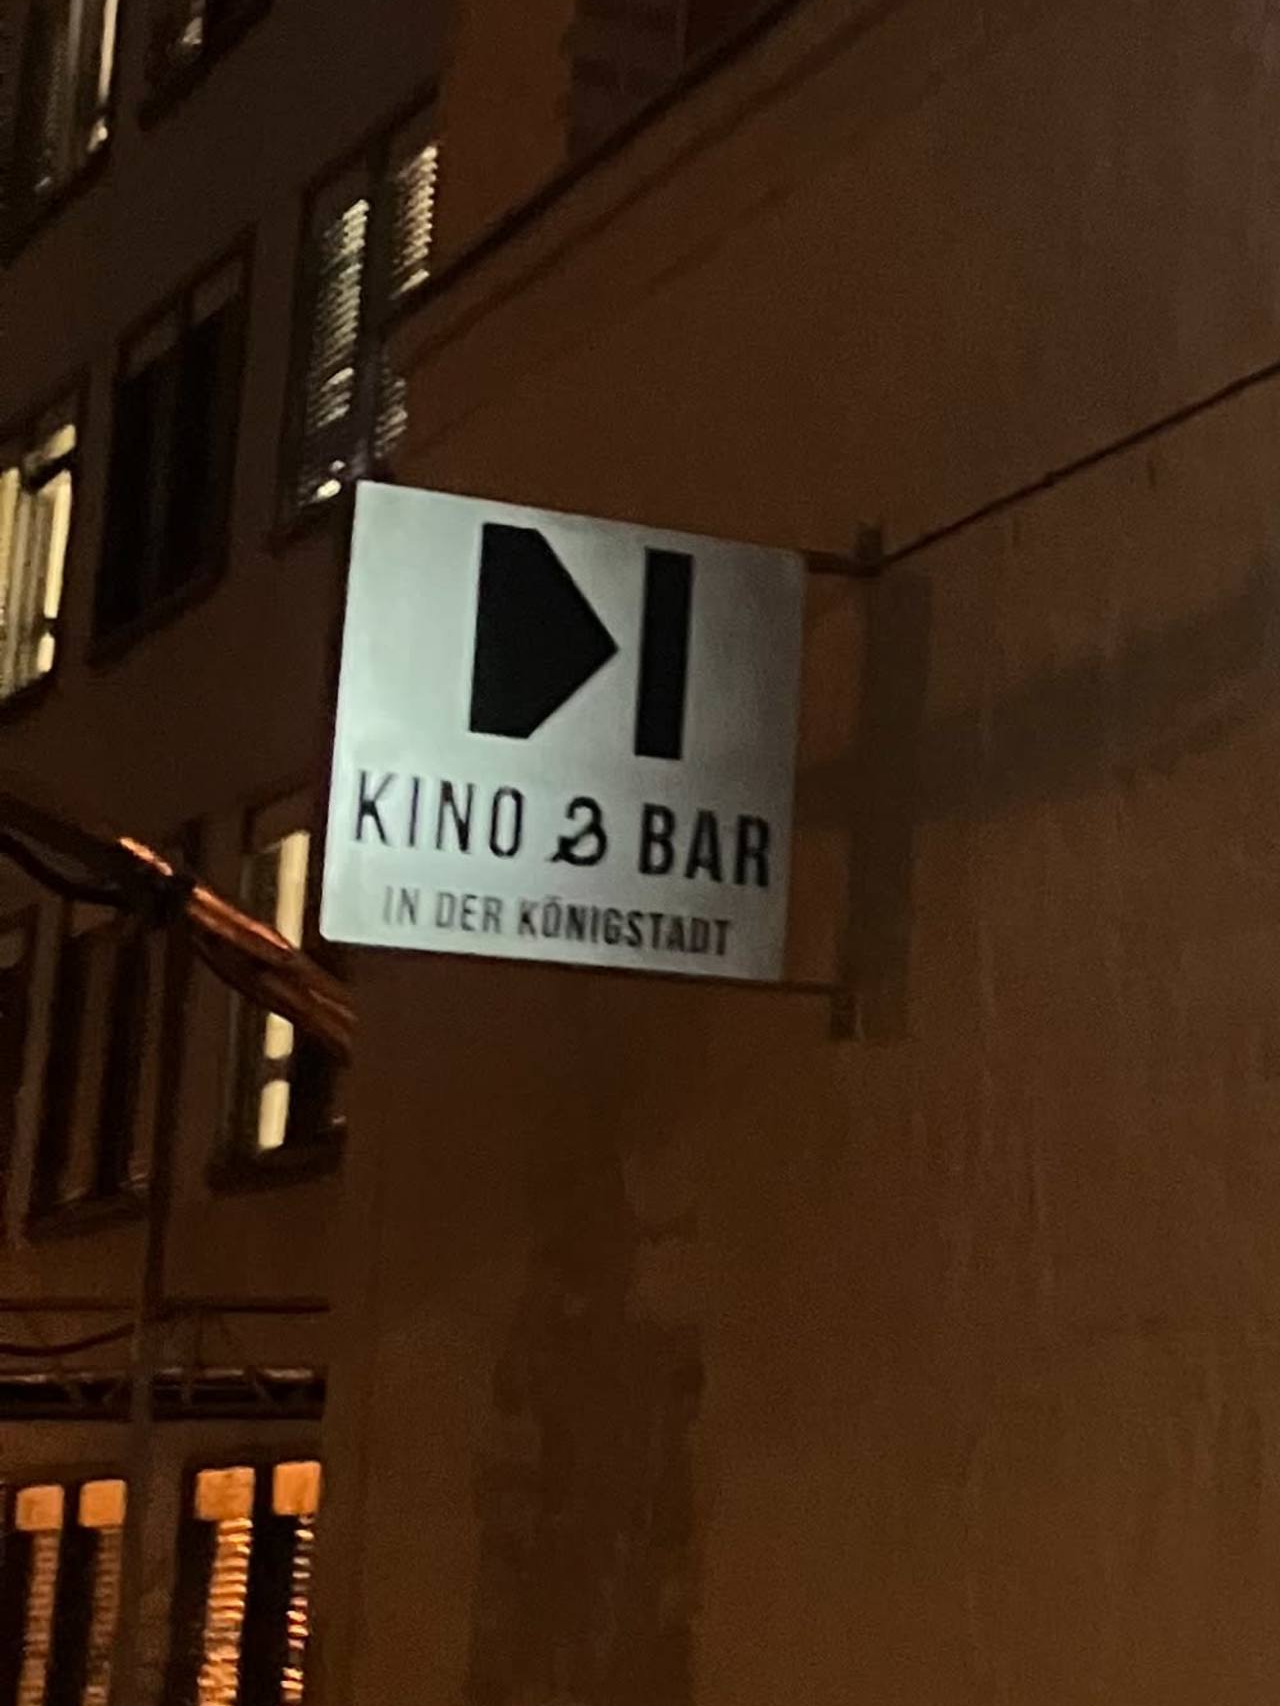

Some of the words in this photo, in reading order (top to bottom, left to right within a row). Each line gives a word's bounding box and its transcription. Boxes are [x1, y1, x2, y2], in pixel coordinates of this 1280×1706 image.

[354, 769, 524, 858] KINO
[638, 802, 771, 888] BAR
[382, 886, 421, 926] IN
[434, 891, 502, 934] DER
[516, 895, 733, 957] KÖNIGSTADT
